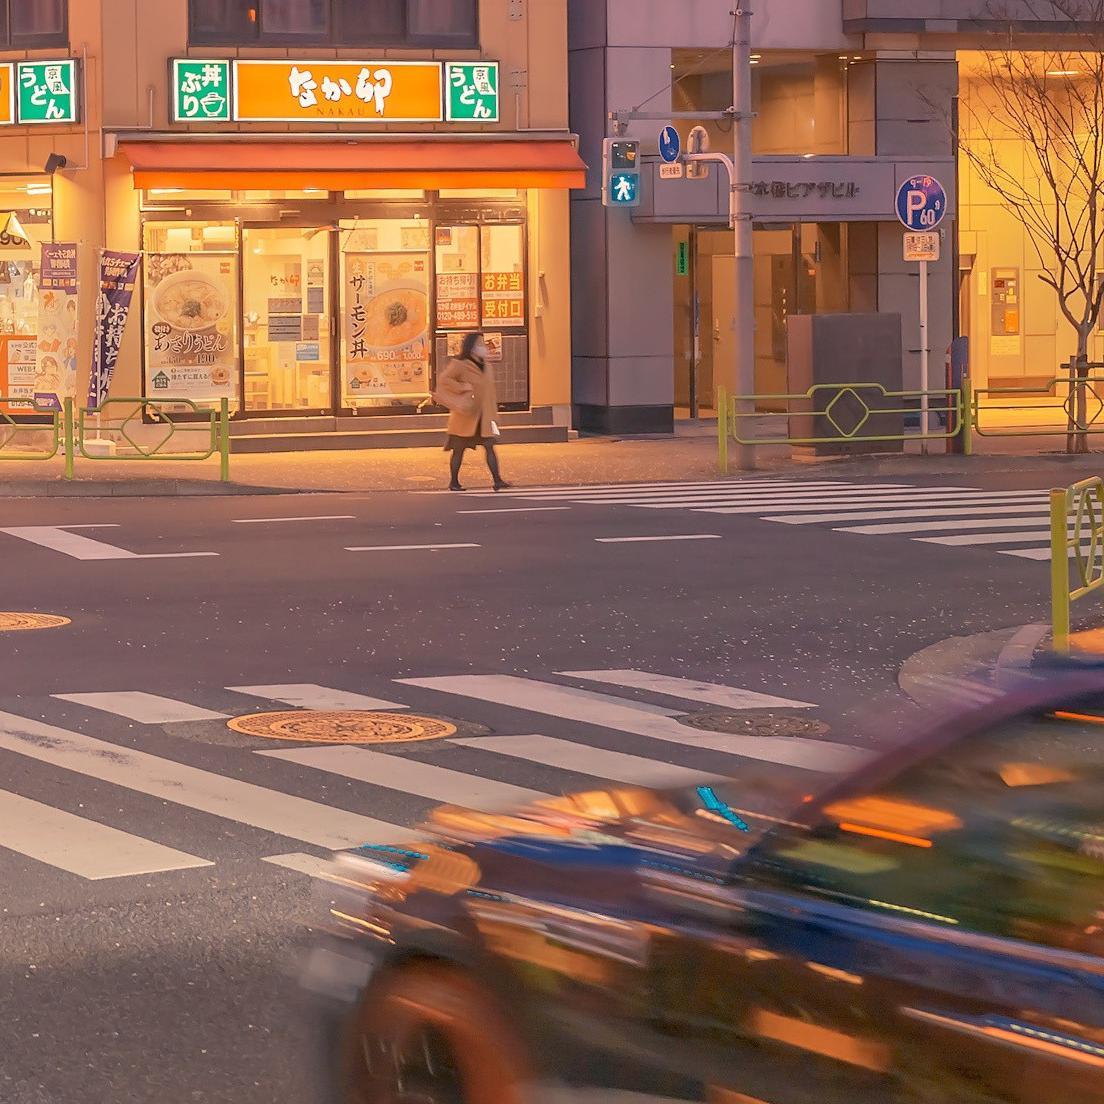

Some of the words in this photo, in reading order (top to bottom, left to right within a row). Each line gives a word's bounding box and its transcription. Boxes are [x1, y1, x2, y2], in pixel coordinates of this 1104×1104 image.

[289, 66, 393, 116] なか卯
[906, 190, 927, 225] P
[484, 274, 520, 290] お弁当
[350, 275, 368, 359] サーモン丼
[485, 300, 521, 316] 受付口
[155, 331, 225, 354] あさりうどん
